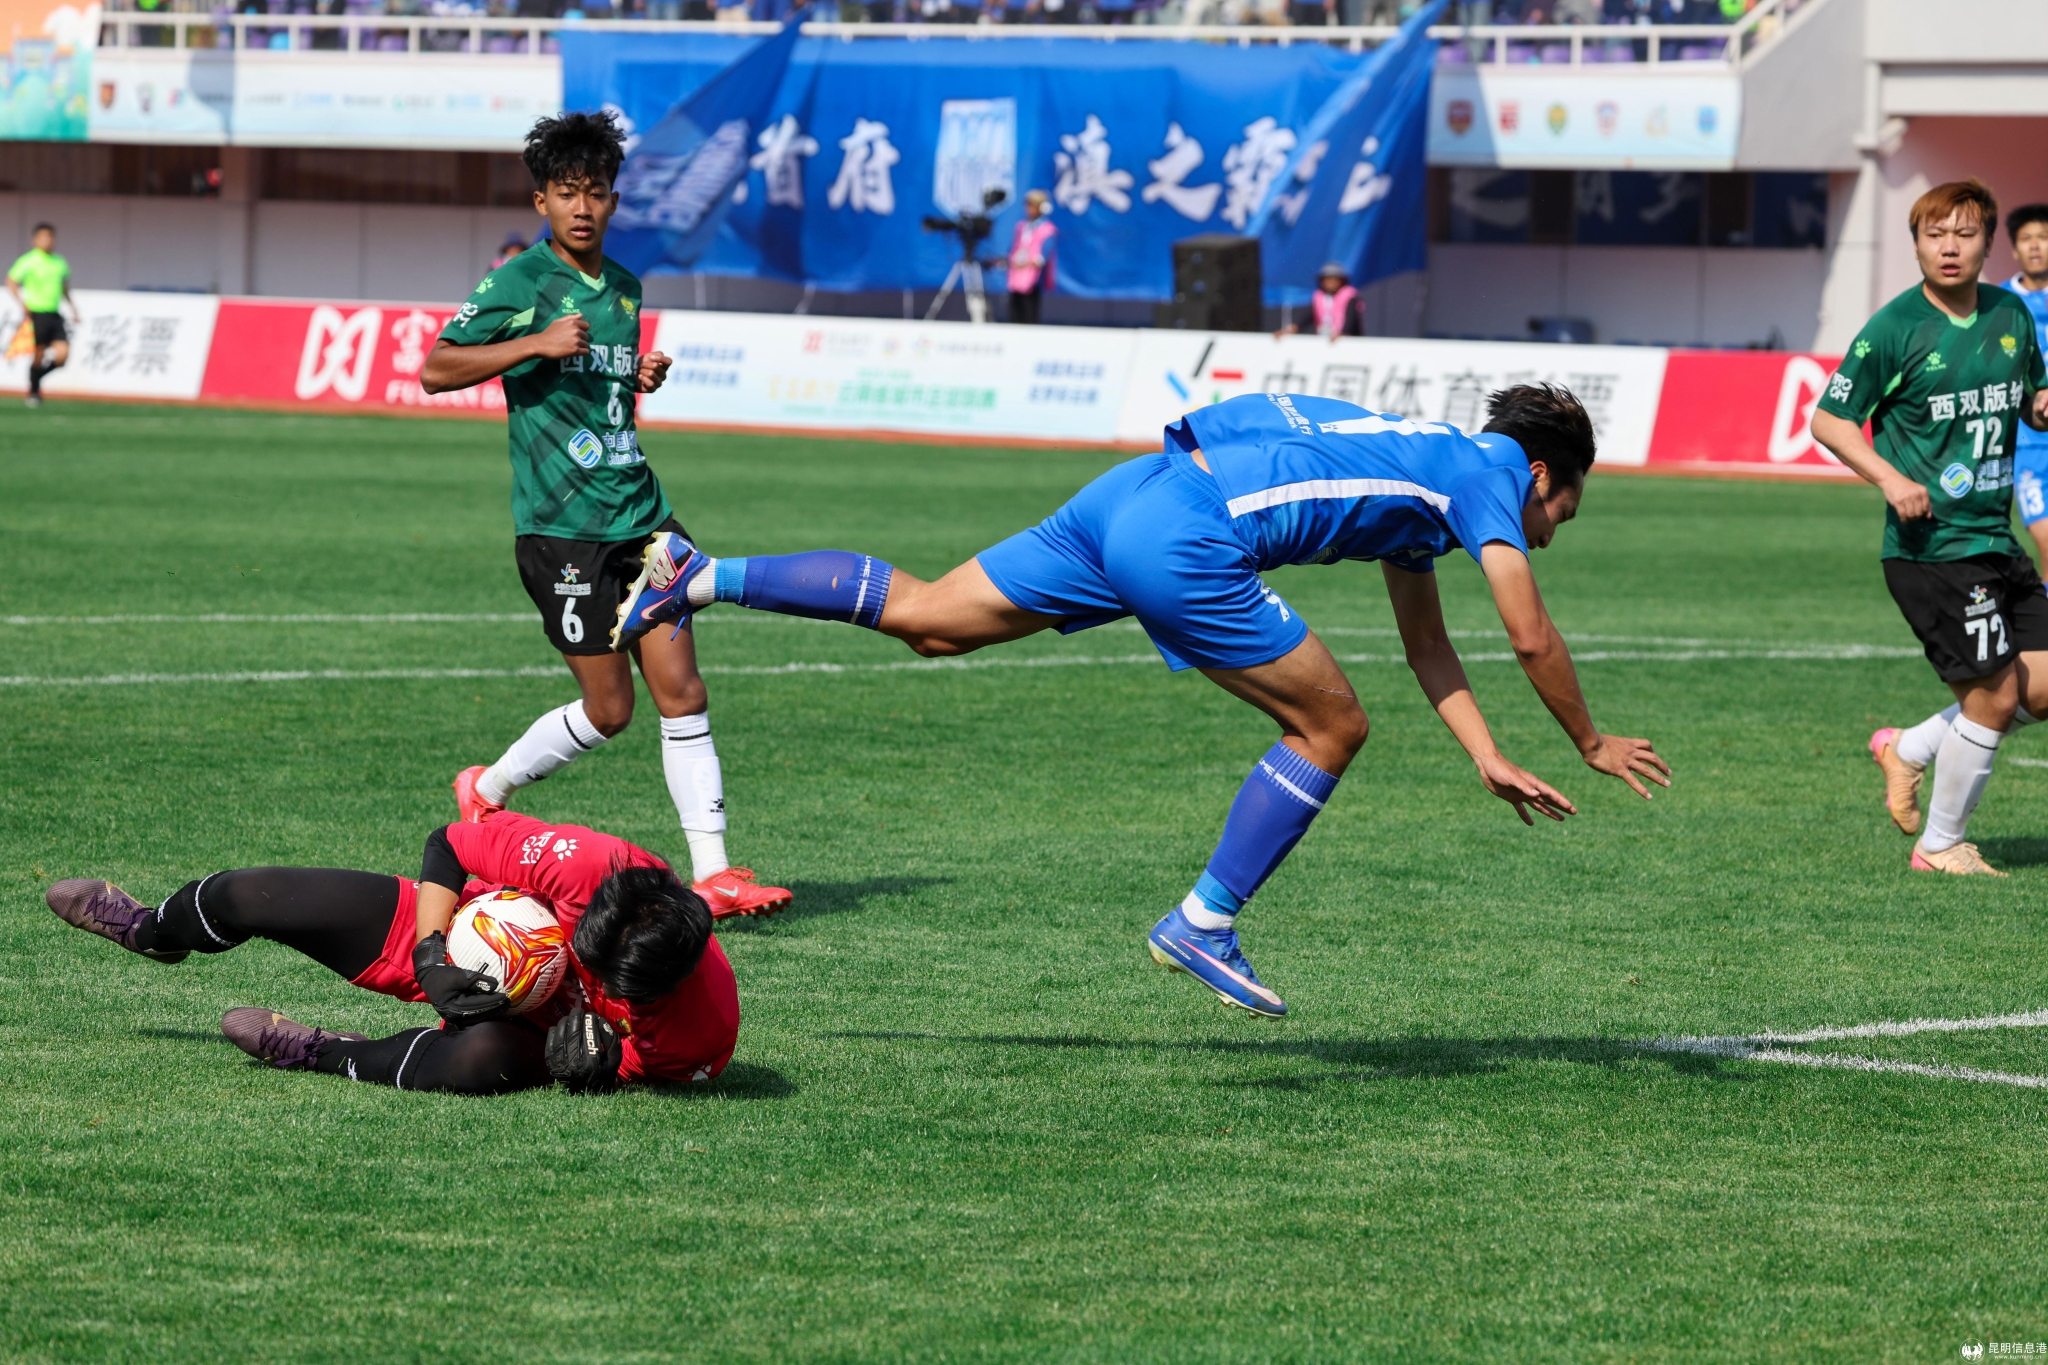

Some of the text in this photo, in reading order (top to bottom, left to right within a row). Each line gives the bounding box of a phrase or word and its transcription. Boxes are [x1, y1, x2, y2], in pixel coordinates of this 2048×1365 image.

[607, 383, 623, 426] 6
[1262, 360, 1621, 436] 中国体育票
[1965, 416, 2003, 459] 72
[2018, 486, 2045, 520] 13
[863, 555, 872, 578] LME
[561, 597, 584, 643] 6
[1964, 613, 2010, 661] 72
[585, 1013, 599, 1055] reusch
